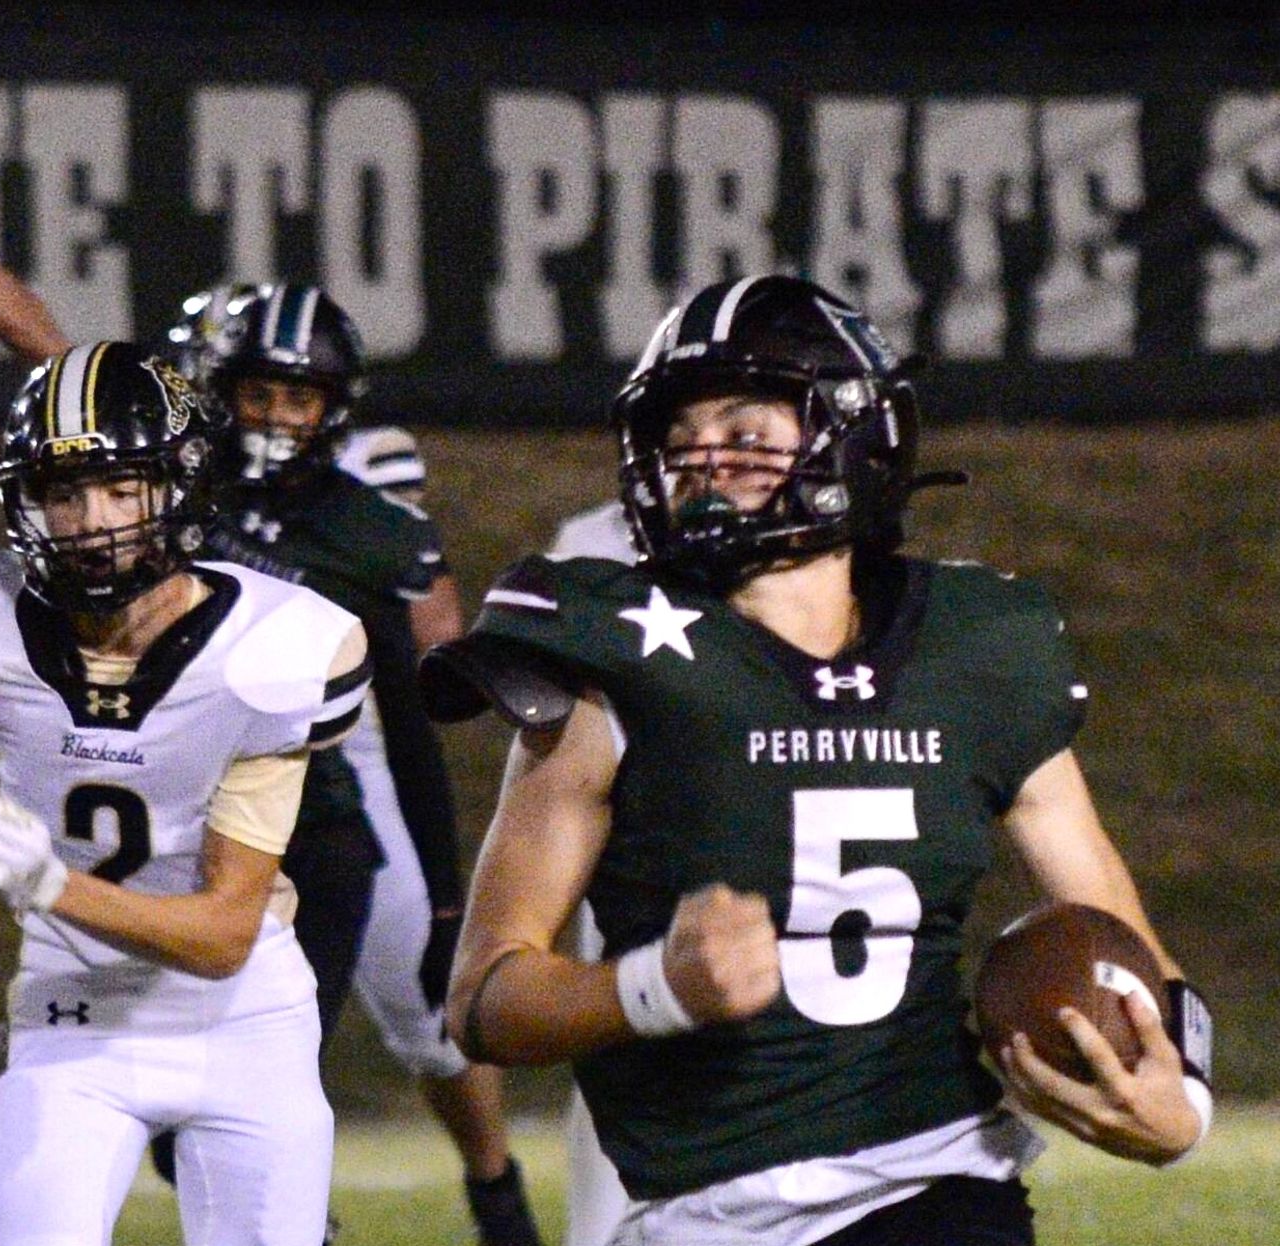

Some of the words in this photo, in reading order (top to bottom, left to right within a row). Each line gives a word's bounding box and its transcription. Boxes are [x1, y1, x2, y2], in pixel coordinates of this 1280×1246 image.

[188, 84, 426, 362] TO
[486, 88, 1147, 362] PIRATE
[60, 733, 146, 766] Blackcats
[748, 728, 943, 764] PERRYVILLE
[61, 780, 156, 887] 2
[776, 787, 923, 1027] 5
